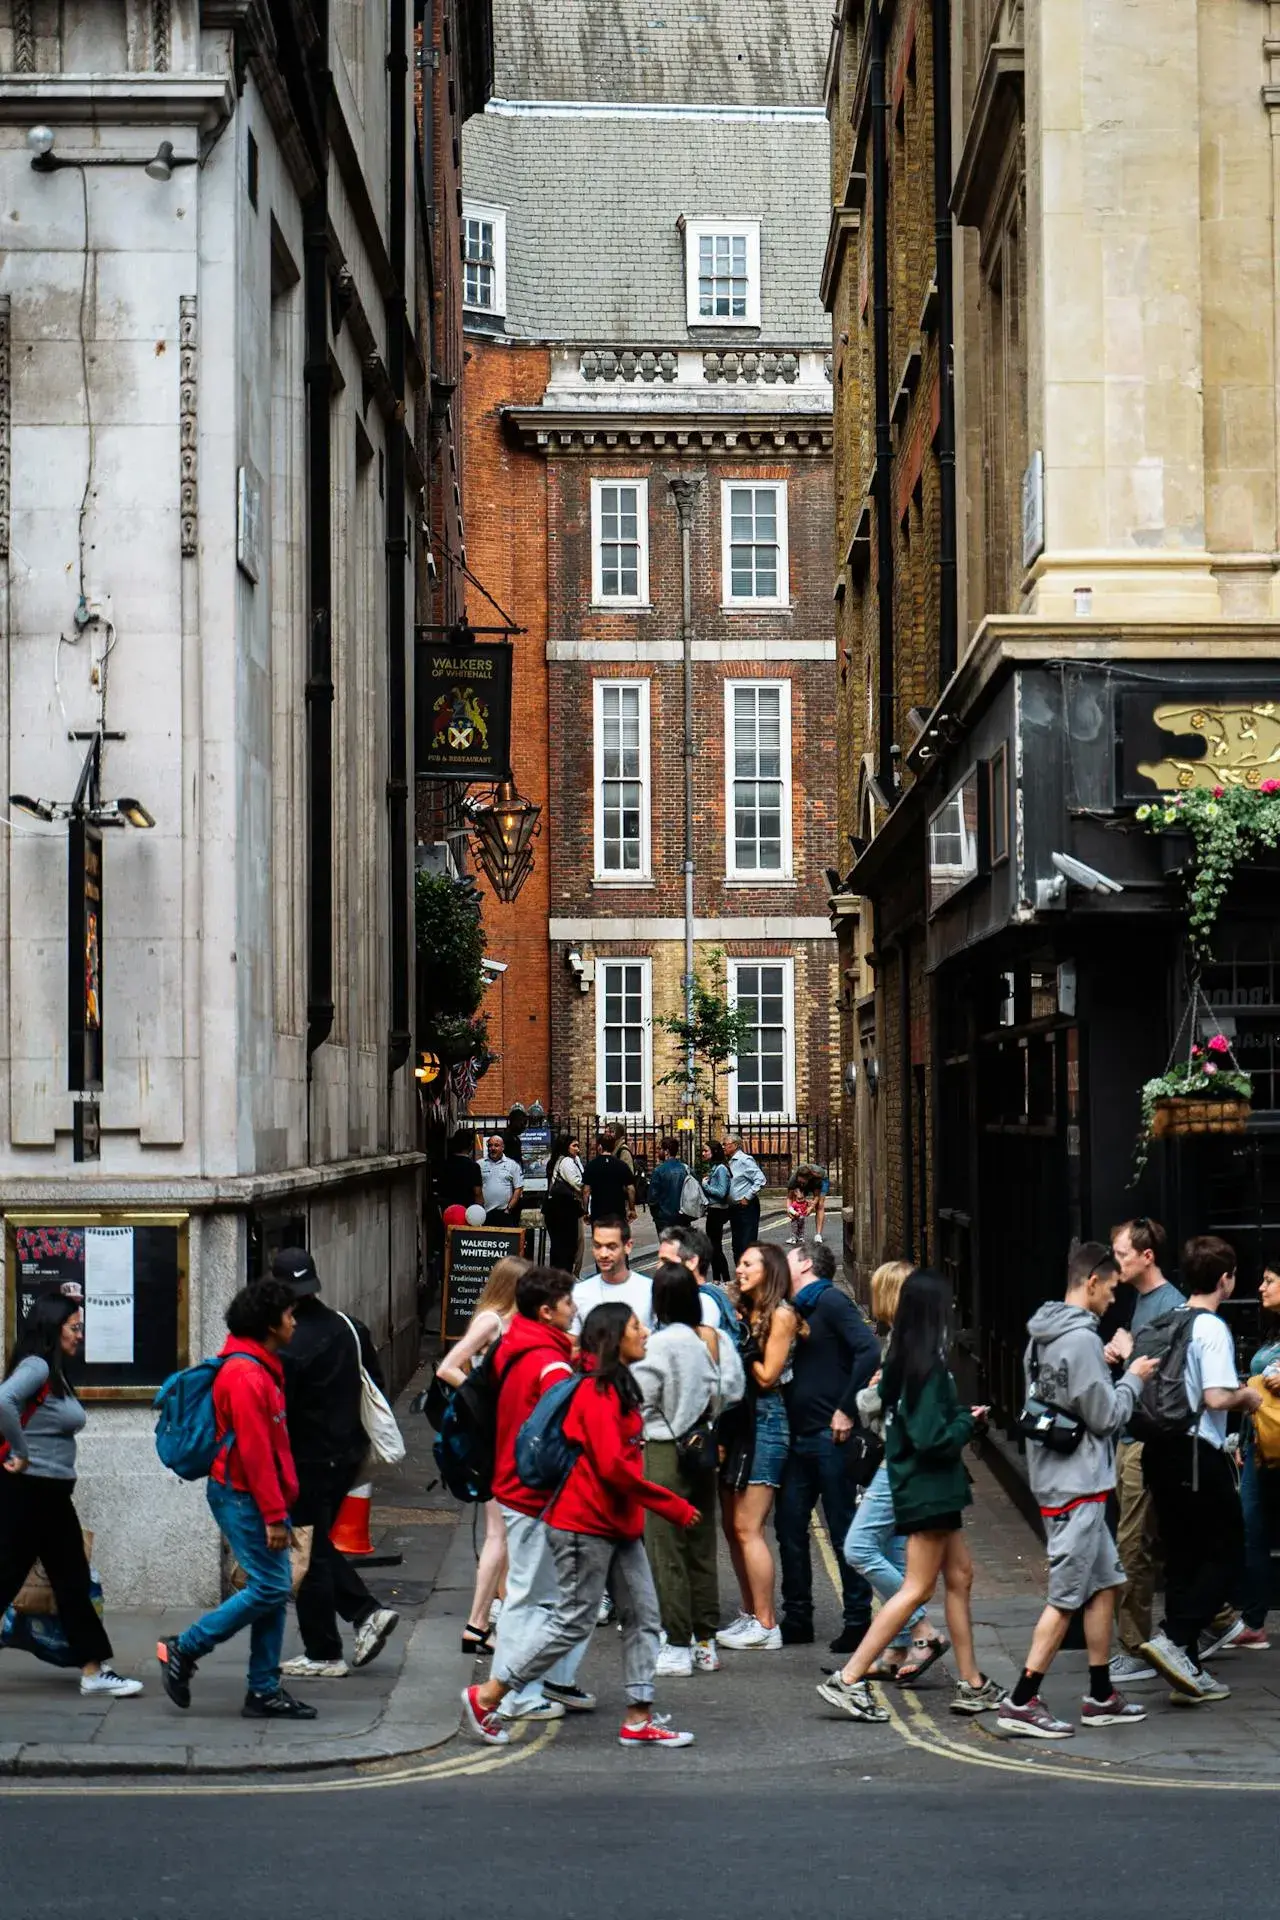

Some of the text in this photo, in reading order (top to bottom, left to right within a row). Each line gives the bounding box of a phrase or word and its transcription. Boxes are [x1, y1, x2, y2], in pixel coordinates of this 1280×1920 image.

[432, 658, 493, 670] WALKERS
[431, 669, 492, 679] OF WHITEHALL
[427, 754, 441, 762] PUB
[460, 1239, 510, 1249] WALKERS OF
[453, 1264, 482, 1272] Welcome
[457, 1286, 479, 1294] Classic
